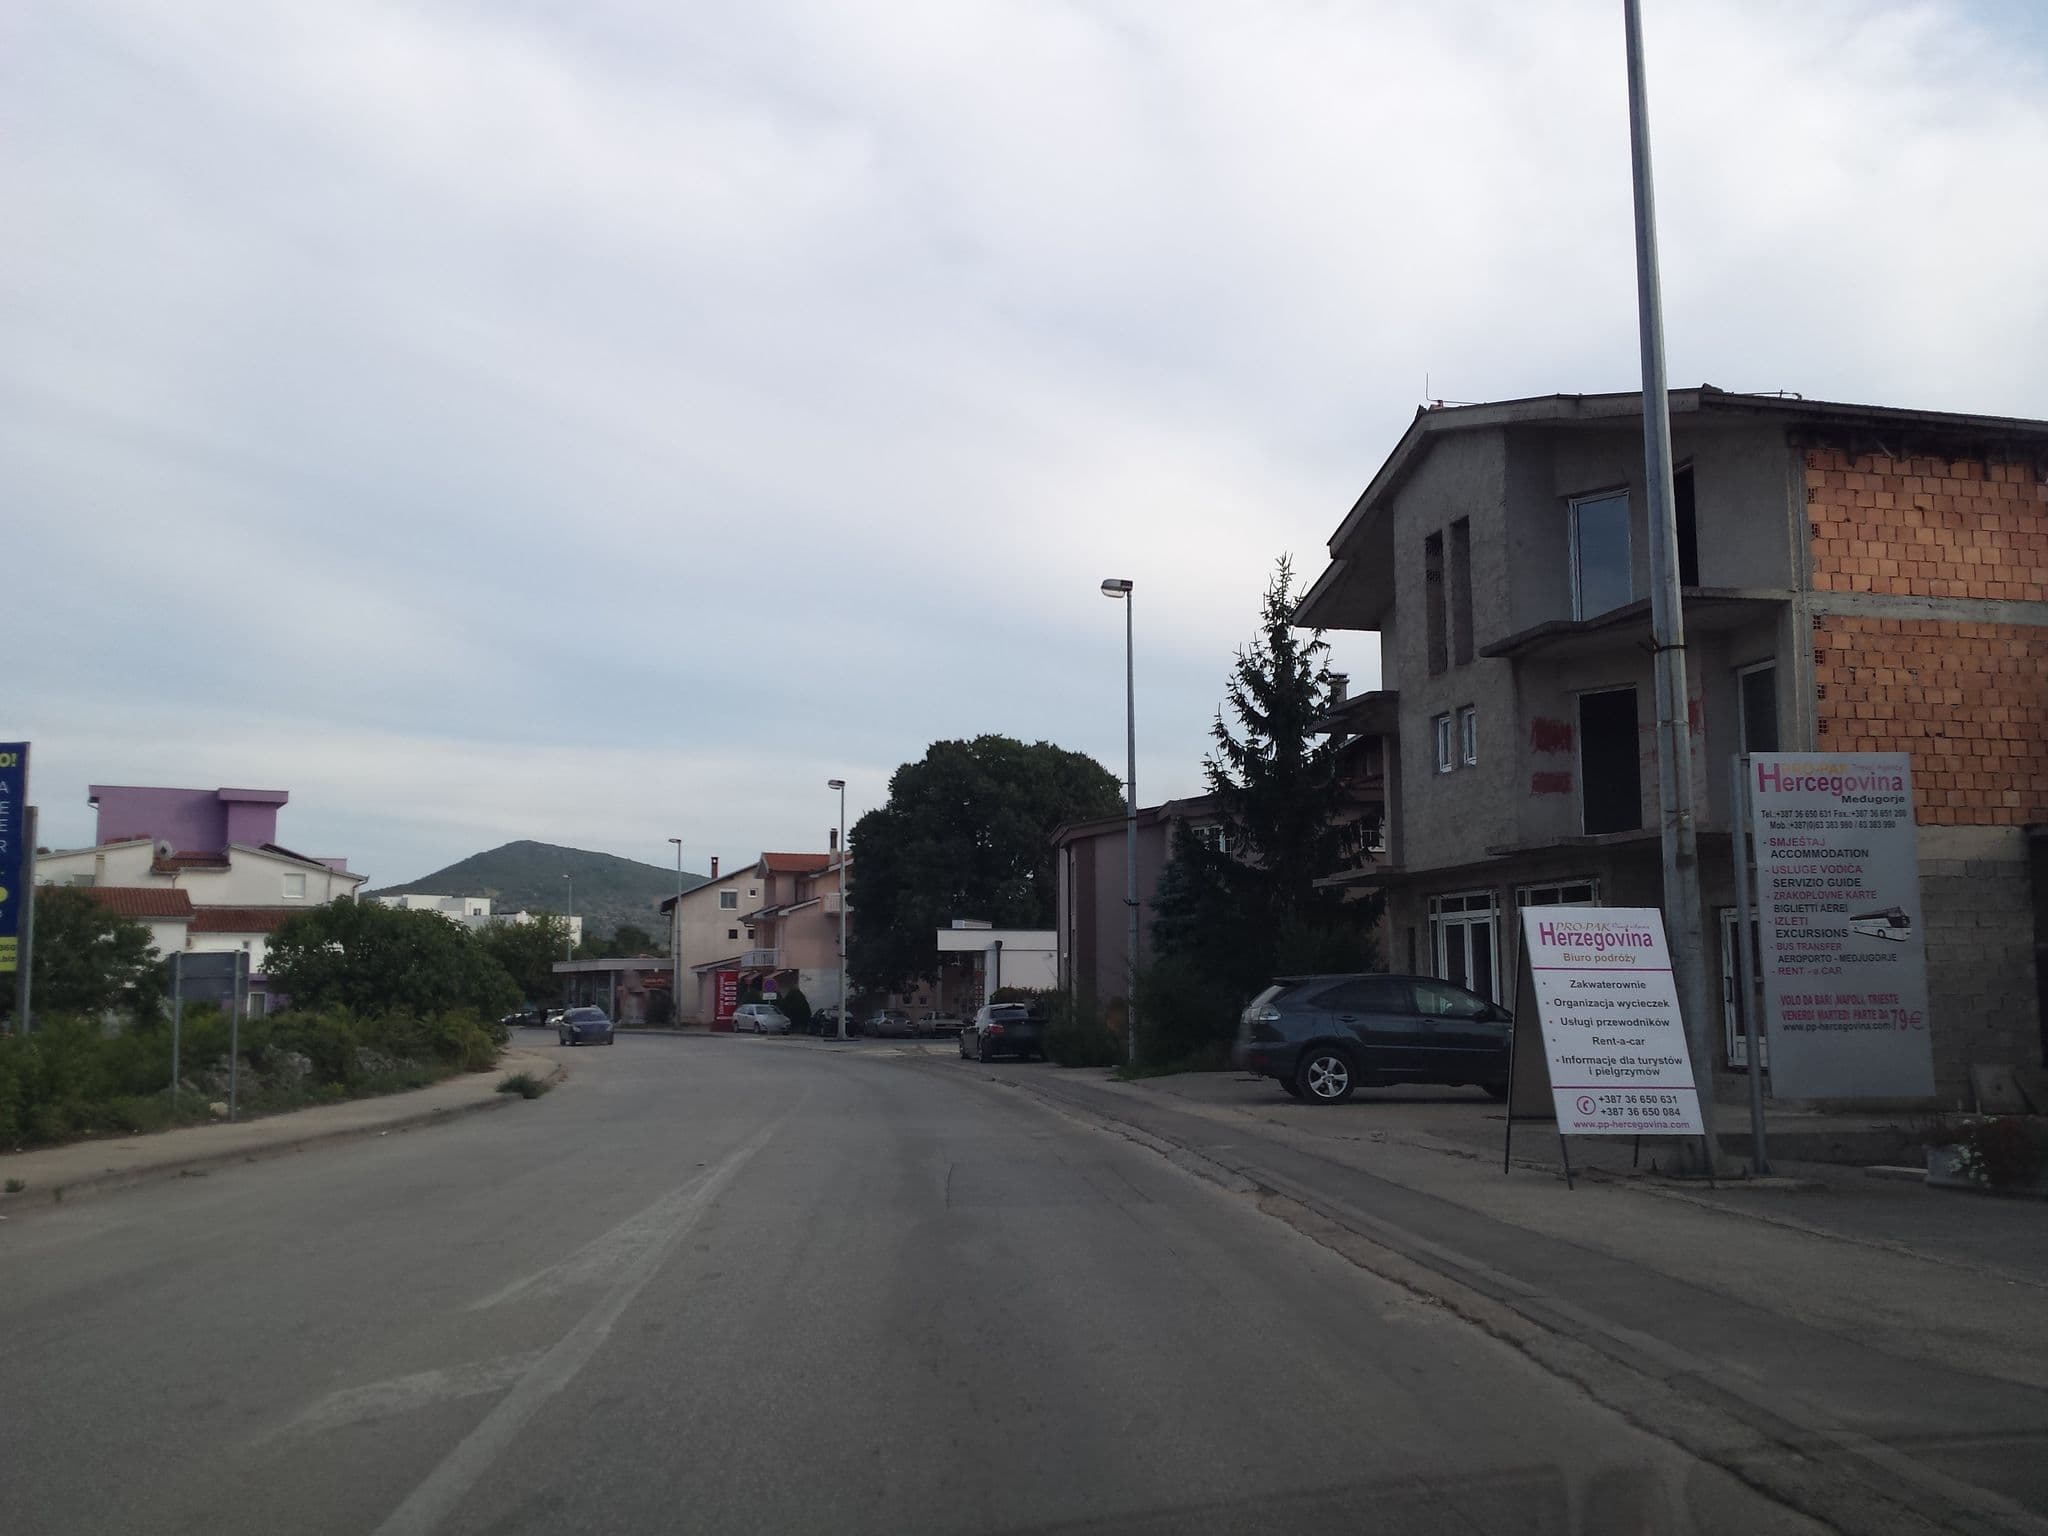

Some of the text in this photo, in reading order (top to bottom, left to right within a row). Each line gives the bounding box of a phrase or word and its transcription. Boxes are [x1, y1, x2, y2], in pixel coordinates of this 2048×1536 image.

[1758, 763, 1904, 796] Hercegovina
[1769, 836, 1825, 847] SMJEŠTAJ
[1771, 849, 1869, 858] ACCOMMODATION
[1772, 865, 1817, 874] USLUGE
[1773, 878, 1861, 887] SERVIZIO GUIDE
[1774, 890, 1877, 900] ZRAKOPLOVNE KARTE
[1774, 904, 1848, 913] BIGLIETTI AEREI
[1775, 917, 1808, 925] IZLETI
[1539, 922, 1654, 952] Herzegovina
[1776, 929, 1849, 938] EXCURSIONS
[1777, 943, 1794, 951] BUS
[1563, 953, 1592, 962] Biuro
[1778, 954, 1832, 963] AEROPORTO
[1839, 954, 1897, 962] MEDJUGORJE
[1778, 967, 1804, 975] RENT
[1821, 967, 1842, 975] CAR
[1569, 979, 1647, 989] Zakwaterownie
[1553, 998, 1670, 1009] Organizacja wycieczek
[1560, 1017, 1593, 1028] Usługi
[1592, 1037, 1645, 1046] Rent-a-car
[1562, 1056, 1683, 1067] Informacje dla turystów
[1598, 1095, 1678, 1104] +387 36 650 631
[1600, 1108, 1681, 1117] +387 36 650 084
[1573, 1121, 1691, 1130] www.pp-hercegovina.com
